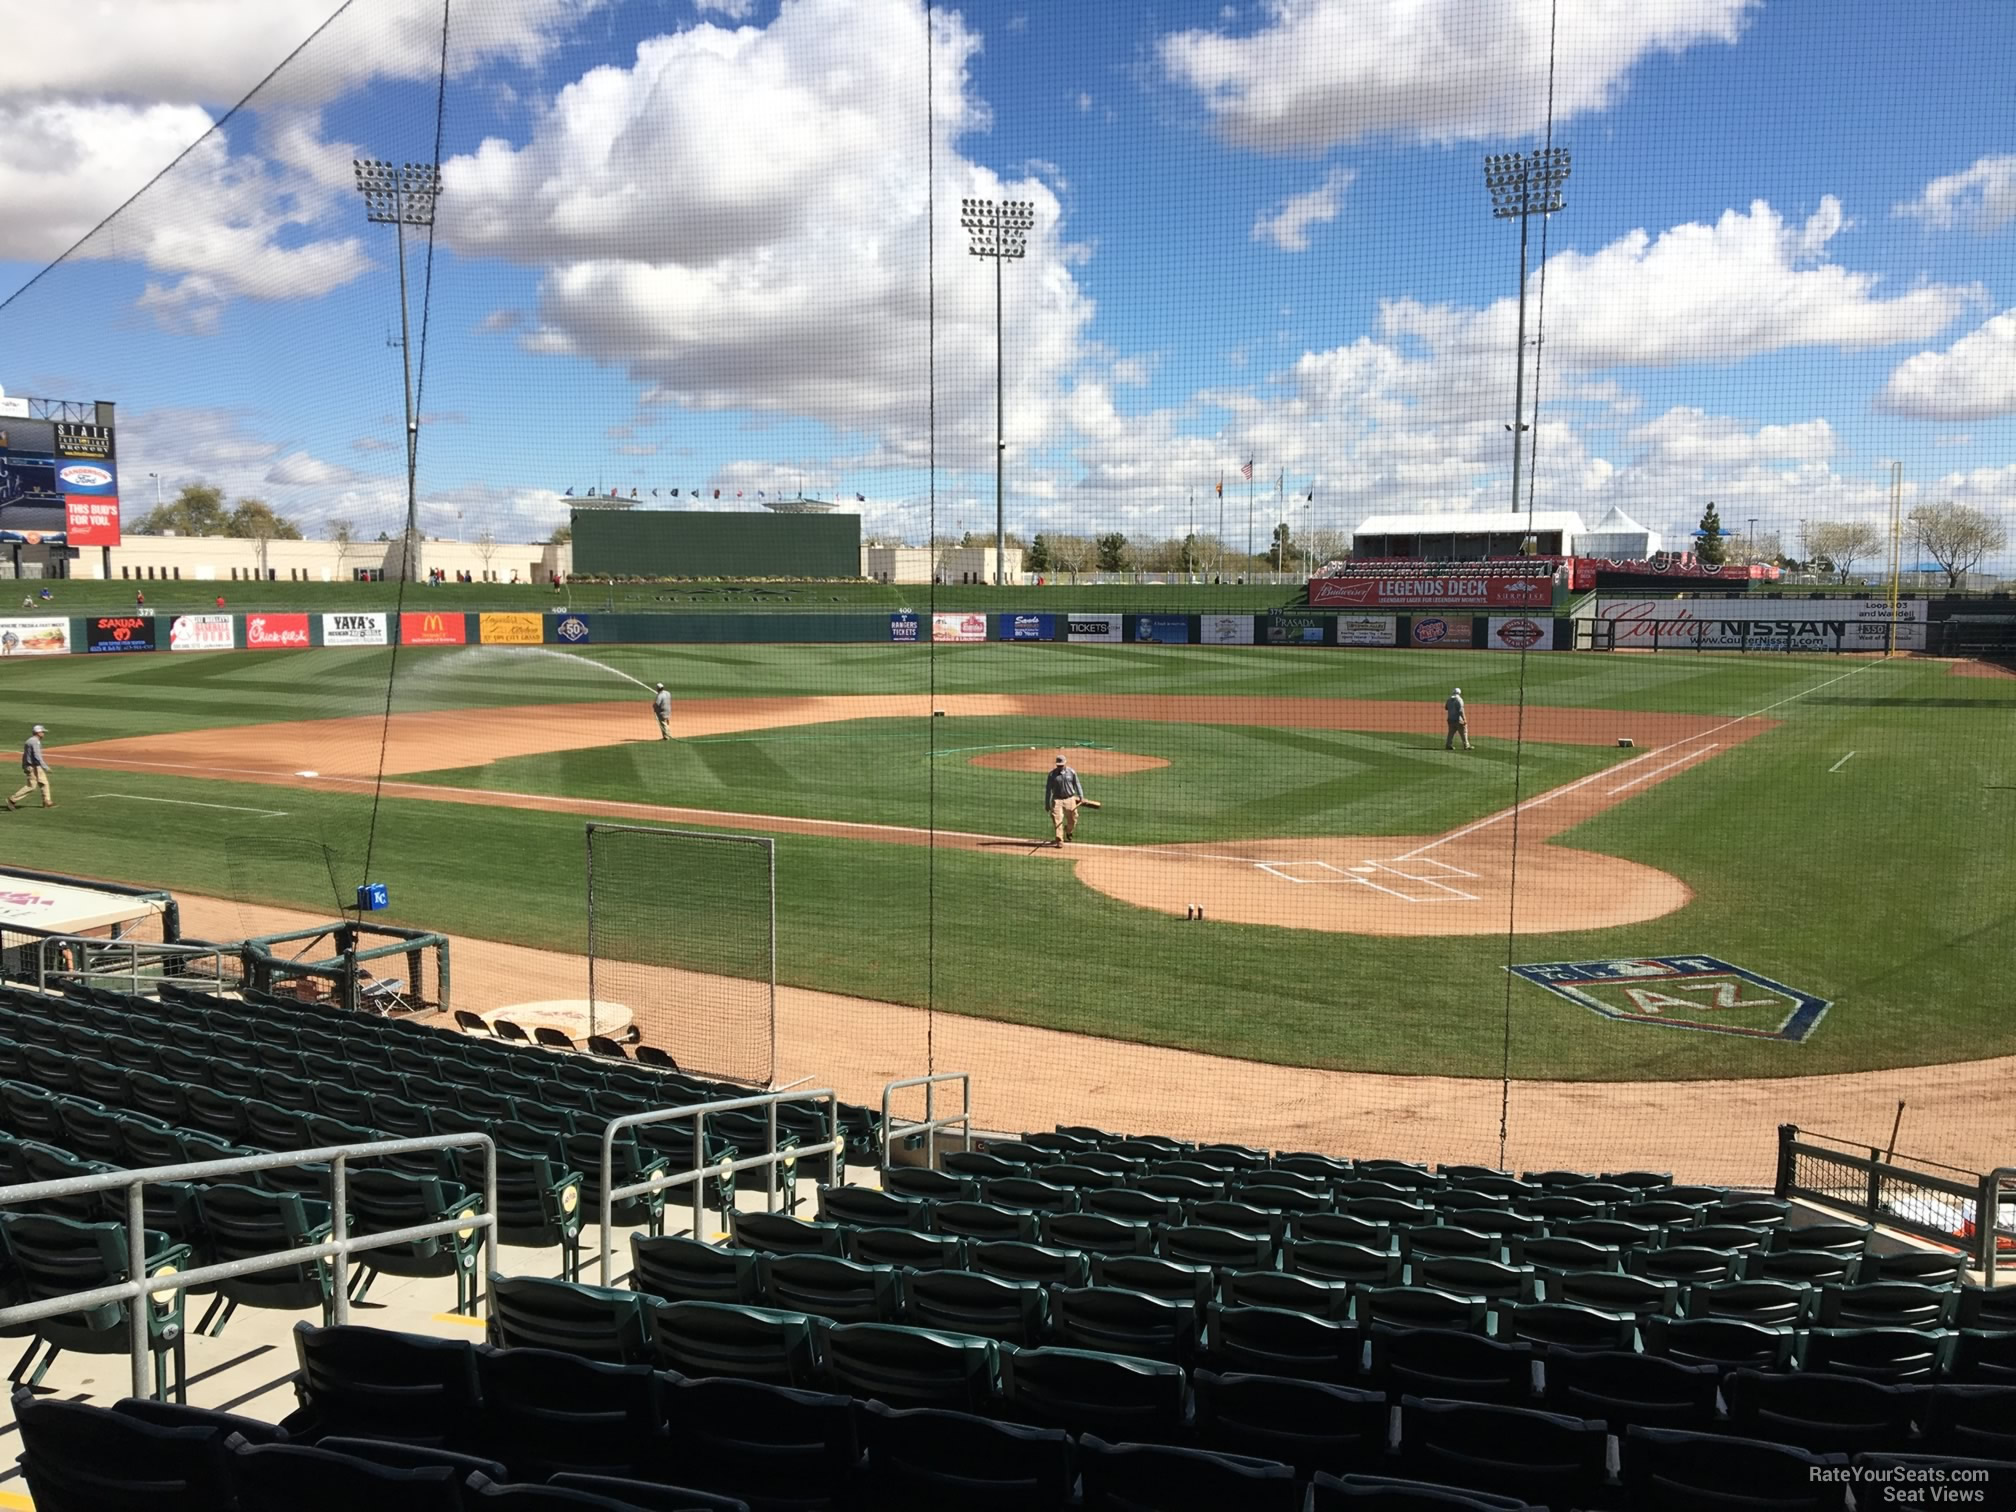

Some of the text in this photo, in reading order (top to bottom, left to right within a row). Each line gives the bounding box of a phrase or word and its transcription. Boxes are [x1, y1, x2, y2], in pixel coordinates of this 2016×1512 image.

[57, 424, 109, 438] STATE
[60, 444, 108, 453] BREWERY
[75, 474, 97, 484] Ford
[68, 504, 118, 516] THIS BUD'S
[70, 514, 111, 526] FOR YOU.
[1320, 586, 1367, 597] Budweiser
[1378, 580, 1488, 596] LEGENDS DECK
[1865, 602, 1888, 610] Loop
[138, 608, 154, 616] 379
[97, 618, 145, 629] SAKURA
[1014, 615, 1040, 624] Sands
[1275, 616, 1315, 627] PRASADA
[1601, 602, 1714, 641] Coulter
[248, 618, 308, 645] Chick-fil-A
[566, 624, 580, 634] 50
[892, 628, 916, 636] TICKETS
[1720, 621, 1846, 637] NISSAN
[1864, 625, 1884, 634] 350
[195, 632, 231, 641] TOURS
[1690, 636, 1824, 645] www.CouerNissan.com
[374, 891, 387, 904] KC
[1623, 981, 1781, 1014] AZ
[167, 1327, 174, 1337] K
